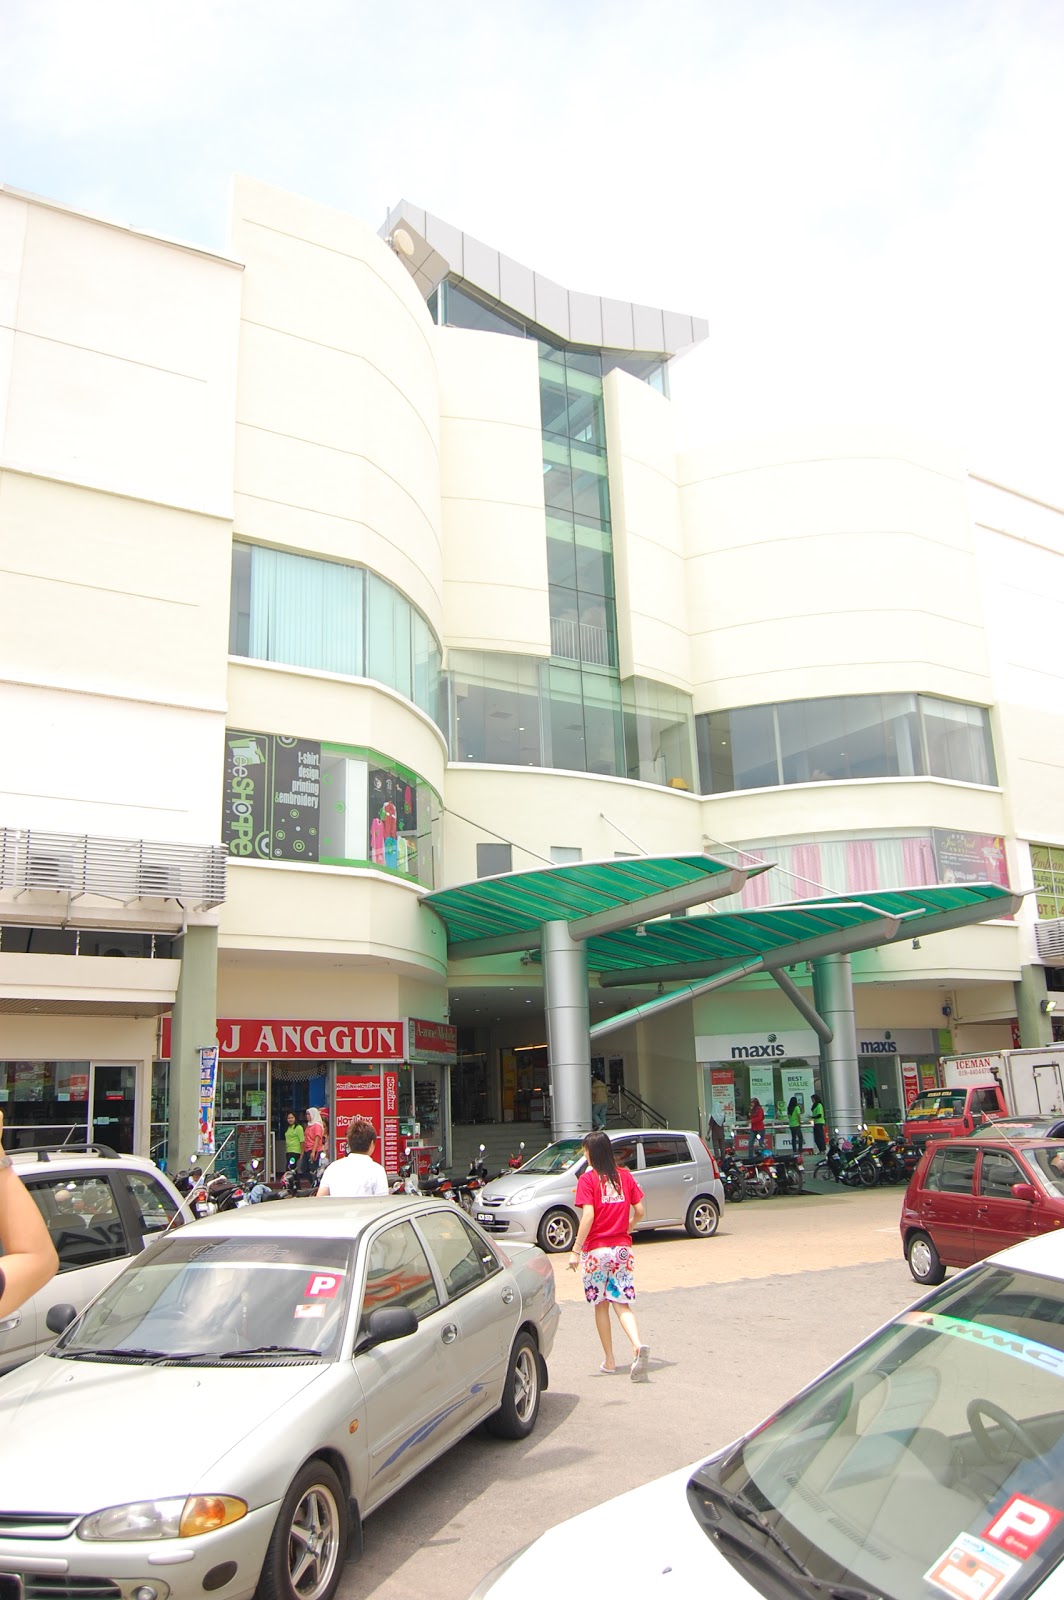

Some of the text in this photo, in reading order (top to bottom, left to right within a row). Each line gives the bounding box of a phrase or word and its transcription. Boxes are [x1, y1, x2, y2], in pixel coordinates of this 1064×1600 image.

[292, 779, 319, 796] printing
[215, 1025, 241, 1053] J
[253, 1025, 397, 1053] ANGGUN
[860, 1041, 897, 1054] maxis
[731, 1044, 785, 1058] maxis
[955, 1058, 991, 1070] ICEMAN
[309, 1276, 336, 1295] P
[988, 1498, 1050, 1540] P
